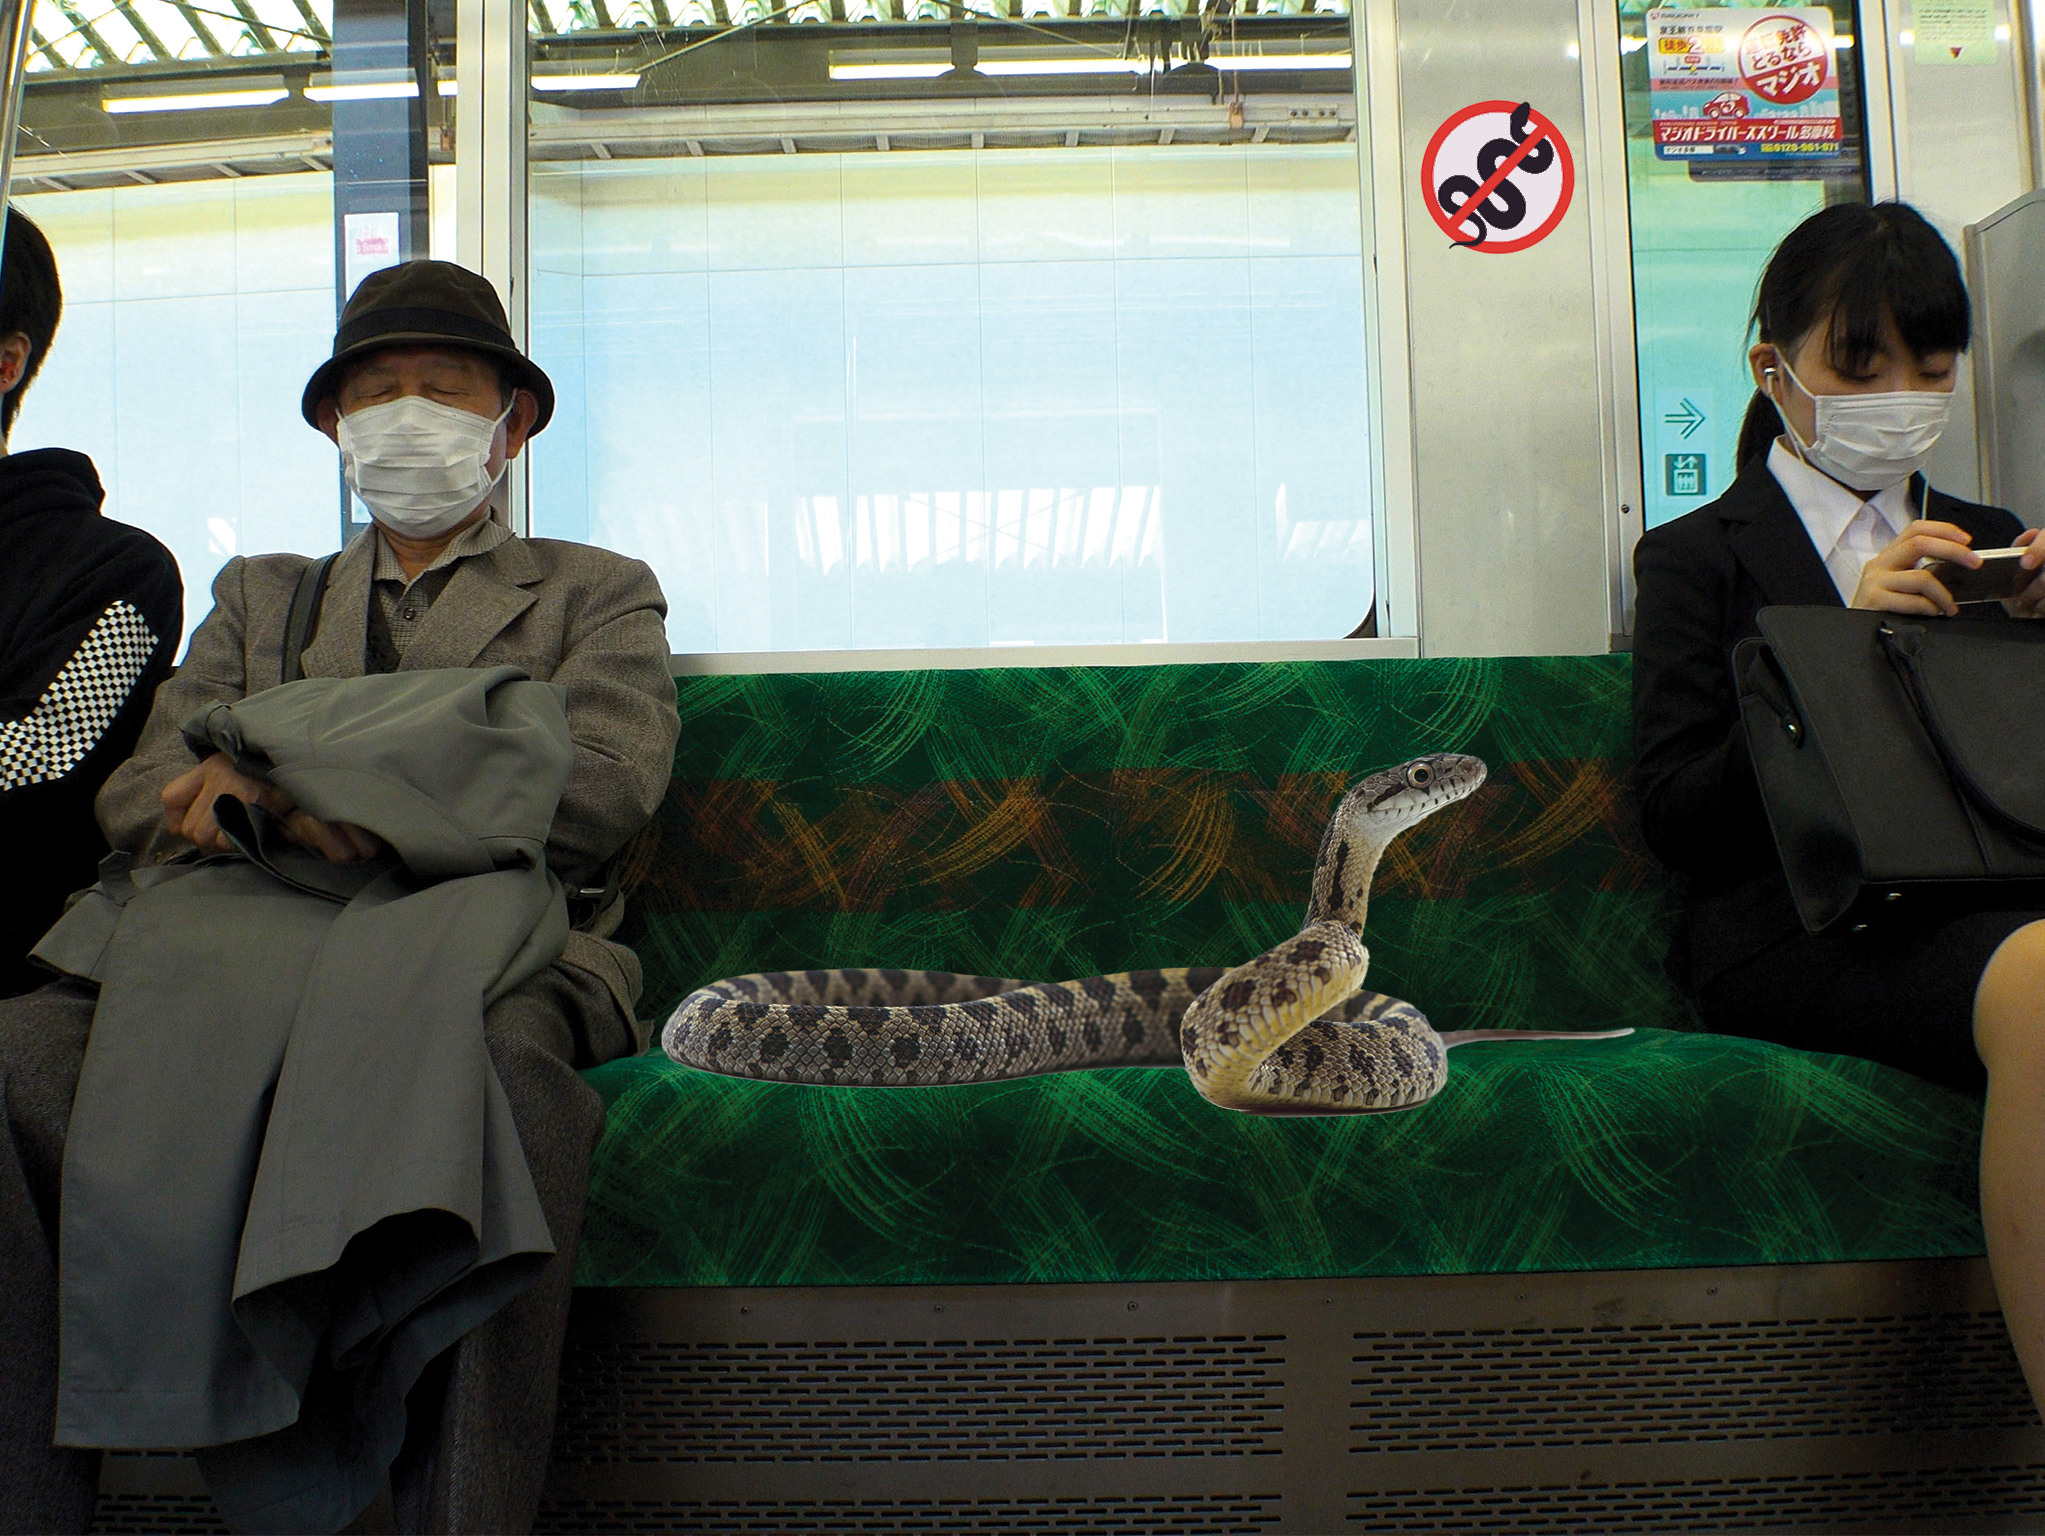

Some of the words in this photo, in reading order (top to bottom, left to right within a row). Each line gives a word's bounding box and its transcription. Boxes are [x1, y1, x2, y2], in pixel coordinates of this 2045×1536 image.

[1752, 41, 1812, 71] とるなら
[1756, 61, 1821, 97] マジオ
